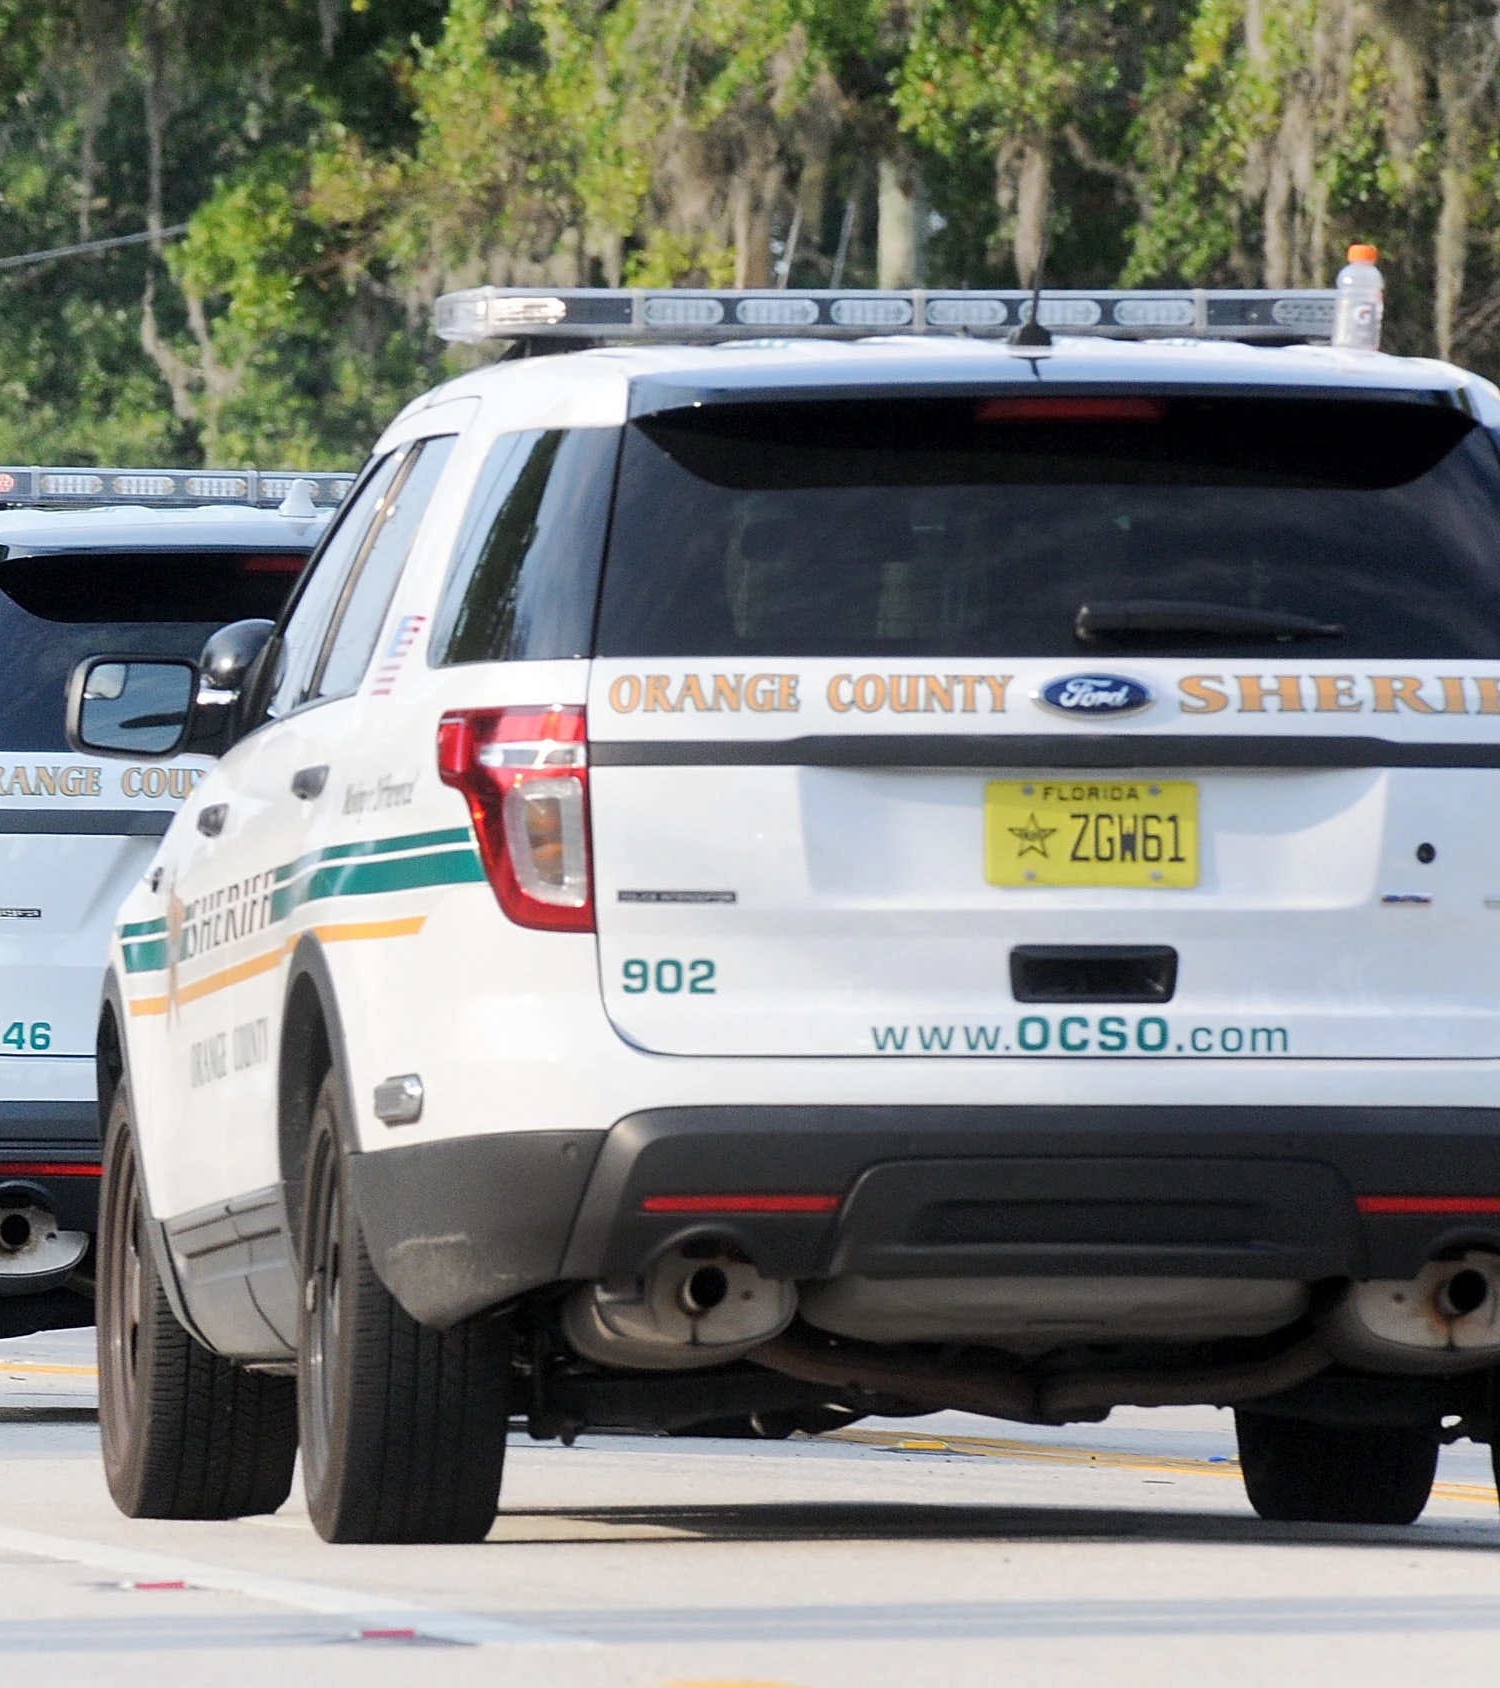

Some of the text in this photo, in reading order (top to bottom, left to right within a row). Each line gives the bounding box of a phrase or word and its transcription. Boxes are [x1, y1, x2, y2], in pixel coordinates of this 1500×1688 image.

[608, 673, 1014, 713] ORANGE COUNTY
[1059, 678, 1130, 708] Ford
[1043, 786, 1140, 801] FLORIDA
[1069, 813, 1186, 862] ZGW61
[186, 868, 276, 958] SHERIFF
[622, 957, 717, 995] 902
[870, 1016, 1290, 1053] www.OCSO.com
